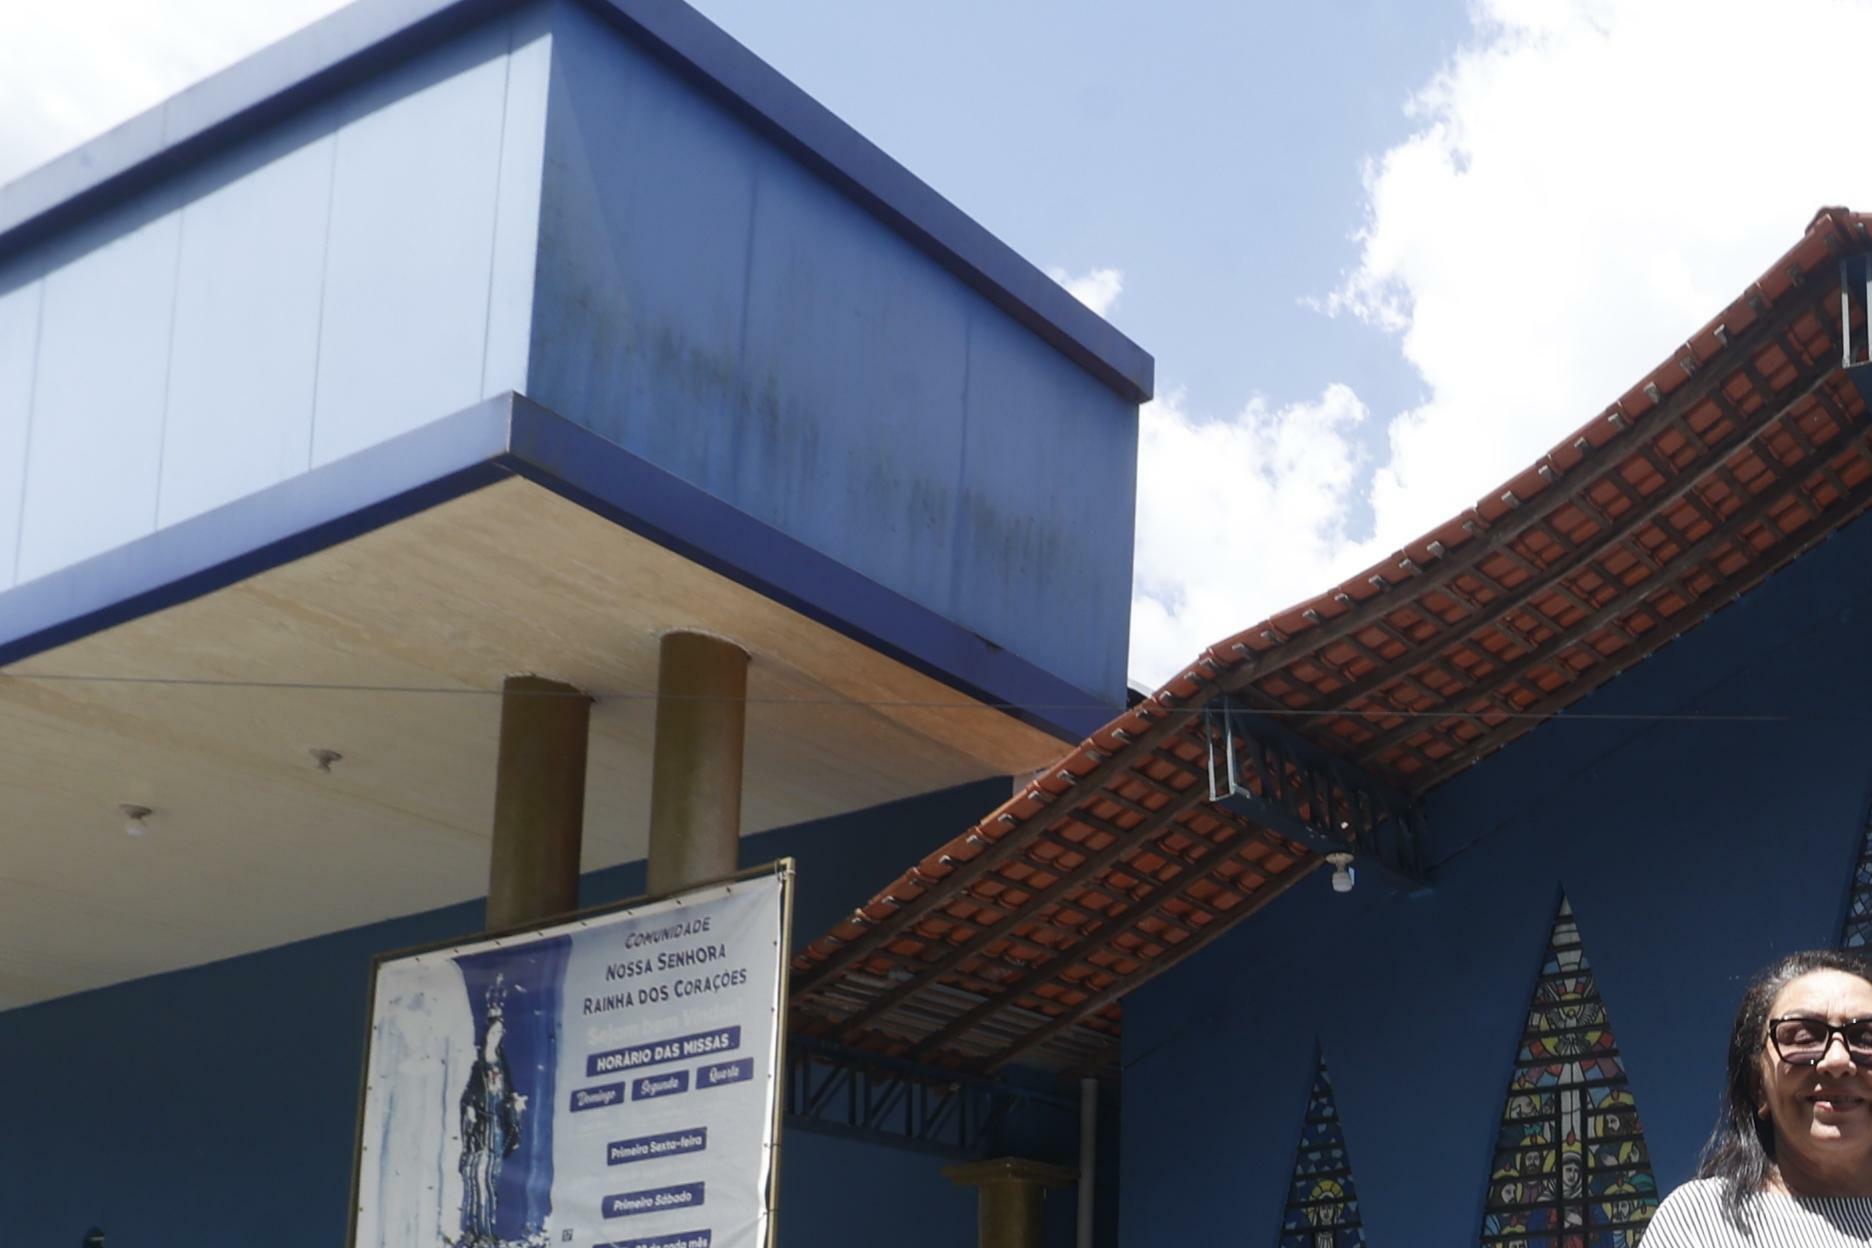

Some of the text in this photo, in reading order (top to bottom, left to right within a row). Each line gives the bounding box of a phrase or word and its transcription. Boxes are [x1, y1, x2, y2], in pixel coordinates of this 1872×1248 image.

[625, 917, 711, 949] COMUNIDADE
[605, 944, 726, 981] NOSSA SENHORA
[583, 968, 748, 1016] RAINHA DOS CORAÇÕES
[596, 1033, 729, 1072] HORÁRIO DAS MISSAS
[709, 1065, 740, 1082] Quarta
[576, 1088, 616, 1107] Domingo
[640, 1077, 680, 1096] Segunda
[650, 1134, 703, 1152] Sexta-feira
[613, 1189, 692, 1212] Primeiro Sábado
